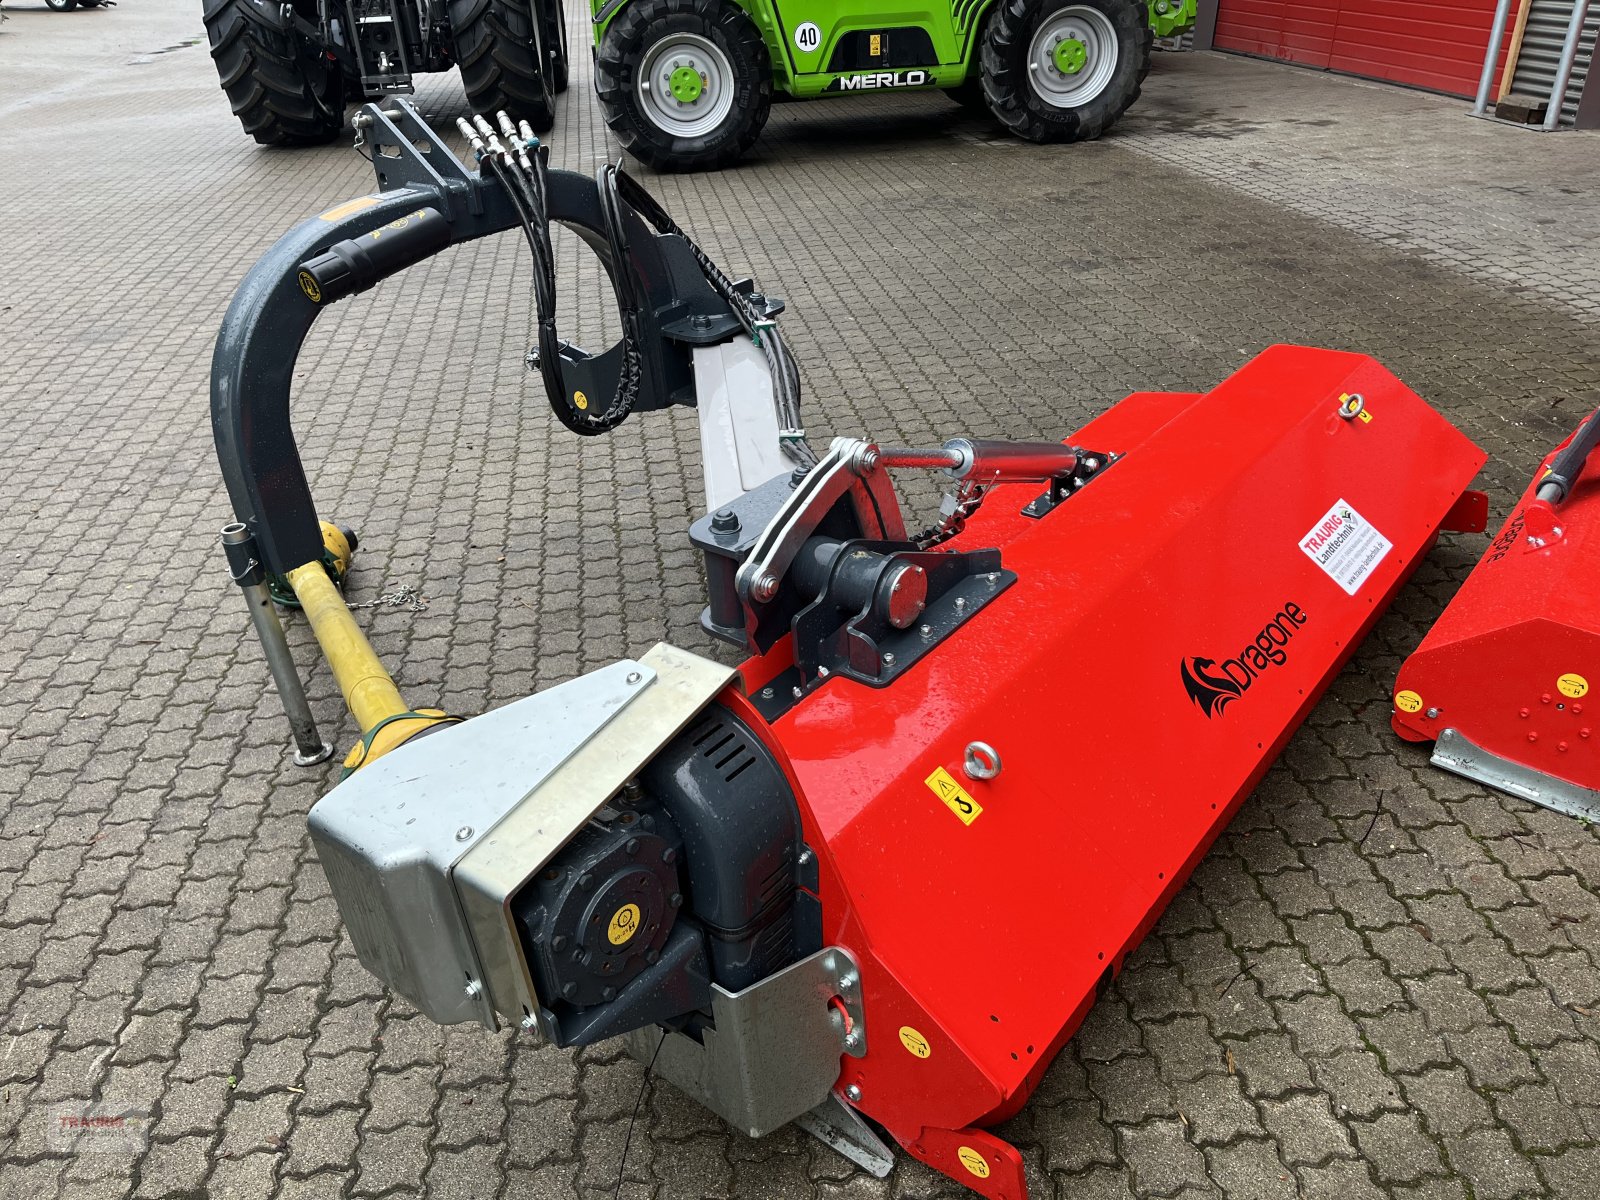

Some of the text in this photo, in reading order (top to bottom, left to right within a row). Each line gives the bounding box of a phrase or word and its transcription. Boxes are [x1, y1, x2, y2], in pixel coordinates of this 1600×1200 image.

[800, 27, 817, 46] 40
[840, 71, 925, 90] MERLO
[1304, 514, 1343, 554] TRAURIG
[1315, 523, 1355, 565] Landtechnik
[1220, 601, 1307, 691] Dragone
